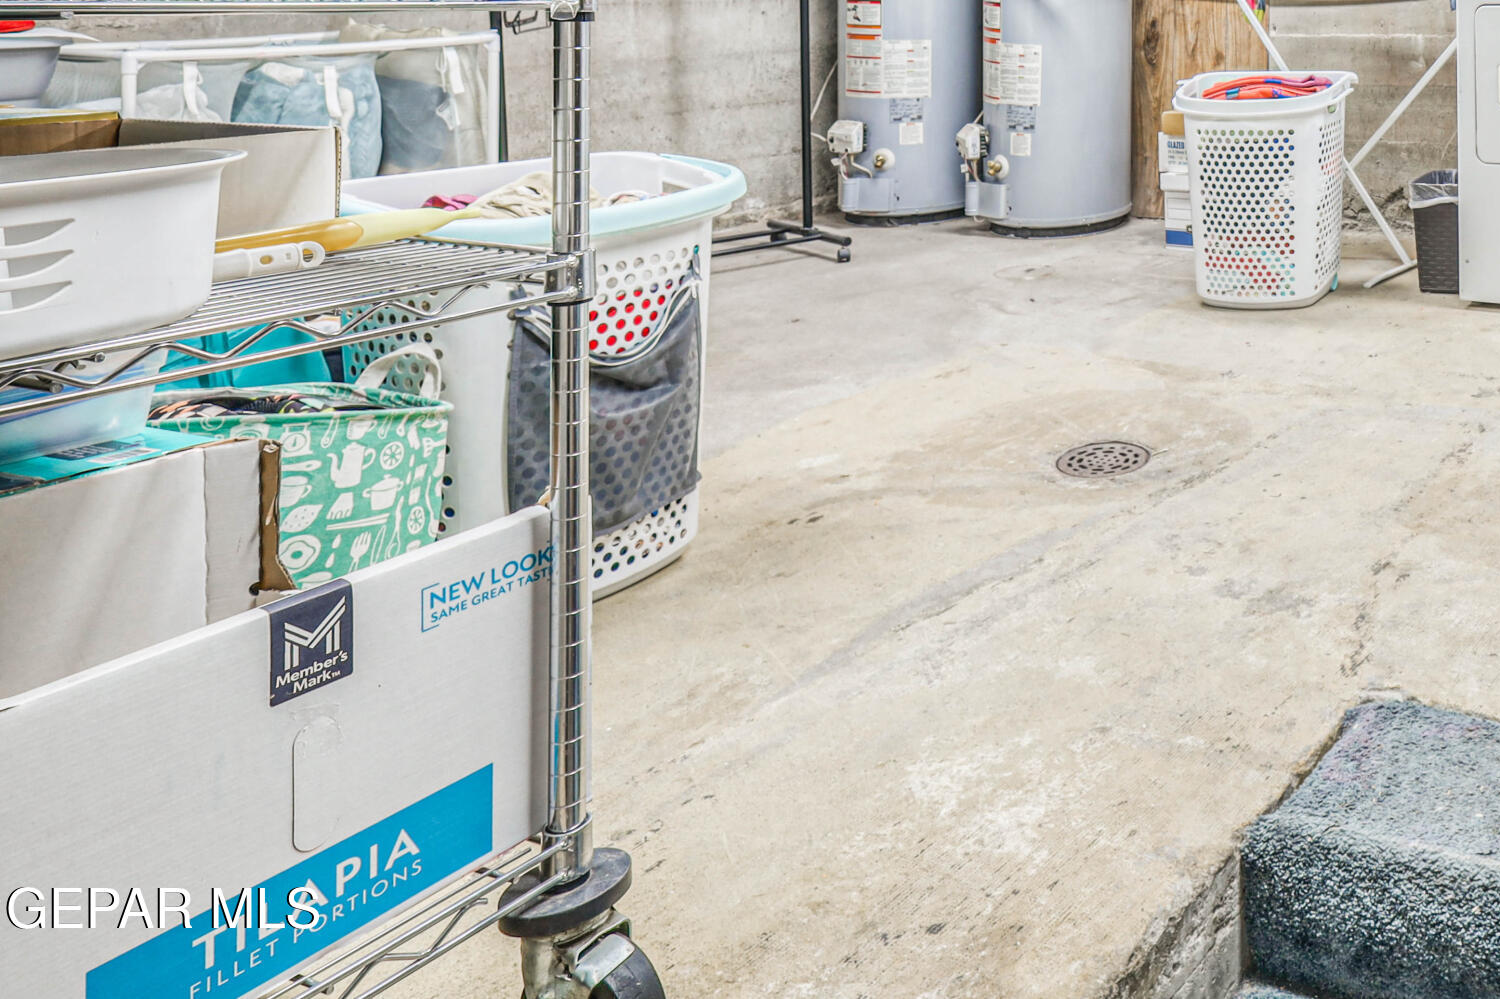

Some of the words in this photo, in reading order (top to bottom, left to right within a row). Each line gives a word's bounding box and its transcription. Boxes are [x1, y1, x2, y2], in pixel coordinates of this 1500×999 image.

[429, 571, 486, 609] NEW
[430, 598, 468, 624] SAME
[471, 582, 514, 607] GREAT
[275, 650, 349, 688] Member's
[189, 938, 280, 999] FILLET
[292, 858, 423, 944] PORTIONS
